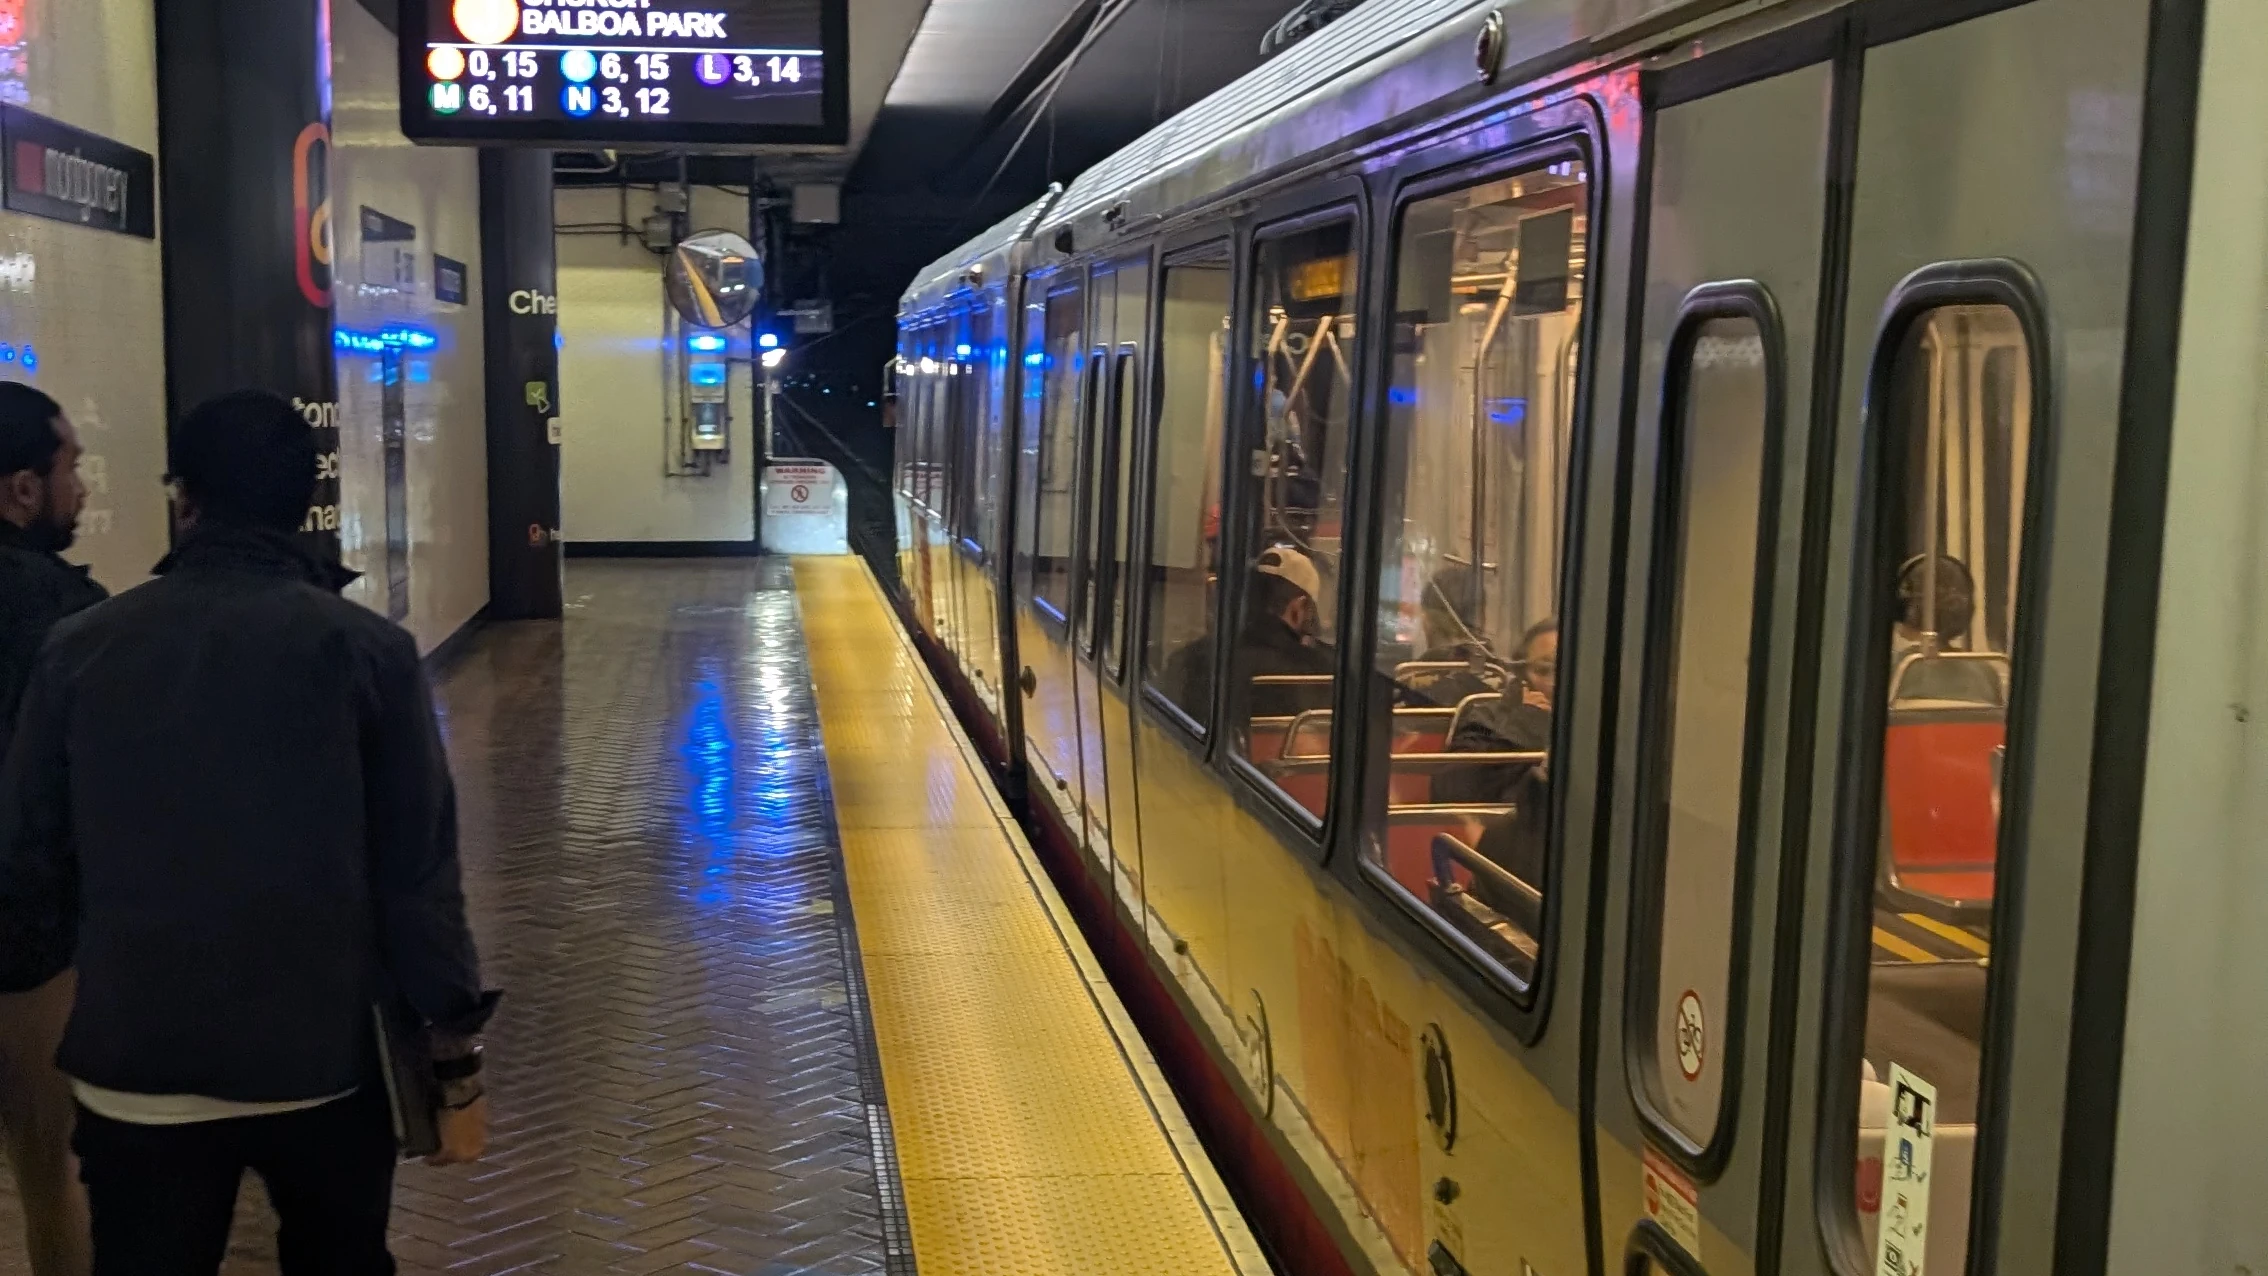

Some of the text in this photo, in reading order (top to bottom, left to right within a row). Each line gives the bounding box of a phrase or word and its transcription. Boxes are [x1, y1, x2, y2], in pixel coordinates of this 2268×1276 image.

[523, 9, 642, 36] BALBOA
[646, 11, 727, 38] PARK
[468, 50, 497, 81] 0,
[502, 51, 538, 78] 15
[600, 52, 629, 83] 6,
[634, 53, 670, 80] 15
[703, 54, 801, 86] L 3, 14
[433, 83, 533, 115] M 6, 11
[568, 86, 670, 117] N 3, 12
